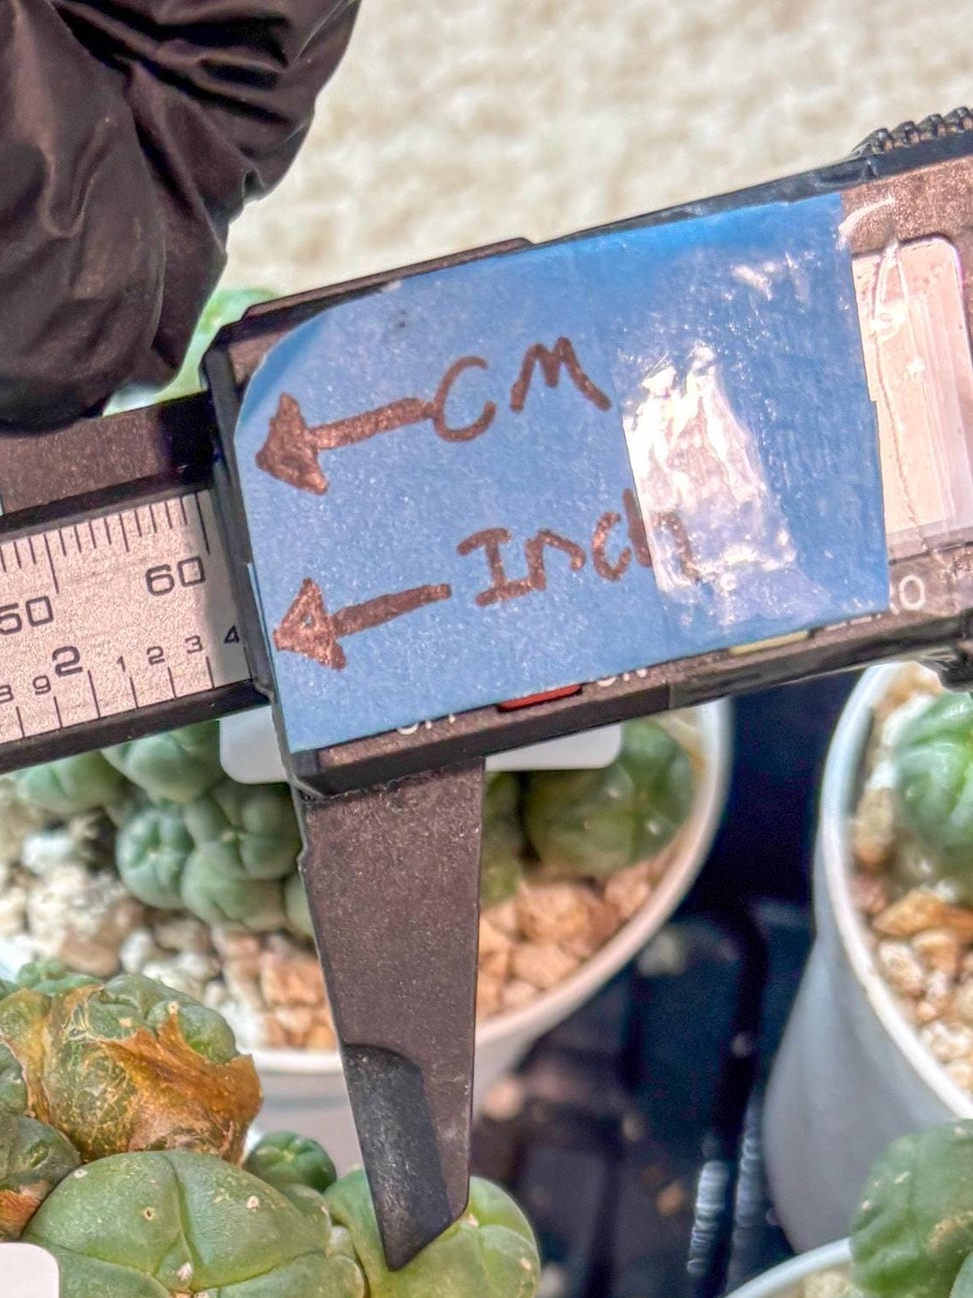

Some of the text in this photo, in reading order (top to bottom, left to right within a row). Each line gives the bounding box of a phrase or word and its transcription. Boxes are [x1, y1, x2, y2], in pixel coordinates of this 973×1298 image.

[432, 336, 611, 442] CM
[144, 556, 206, 597] 60
[31, 674, 52, 696] 9
[51, 645, 84, 678] 2
[146, 645, 166, 666] 2
[184, 635, 204, 655] 3
[223, 625, 241, 644] 4
